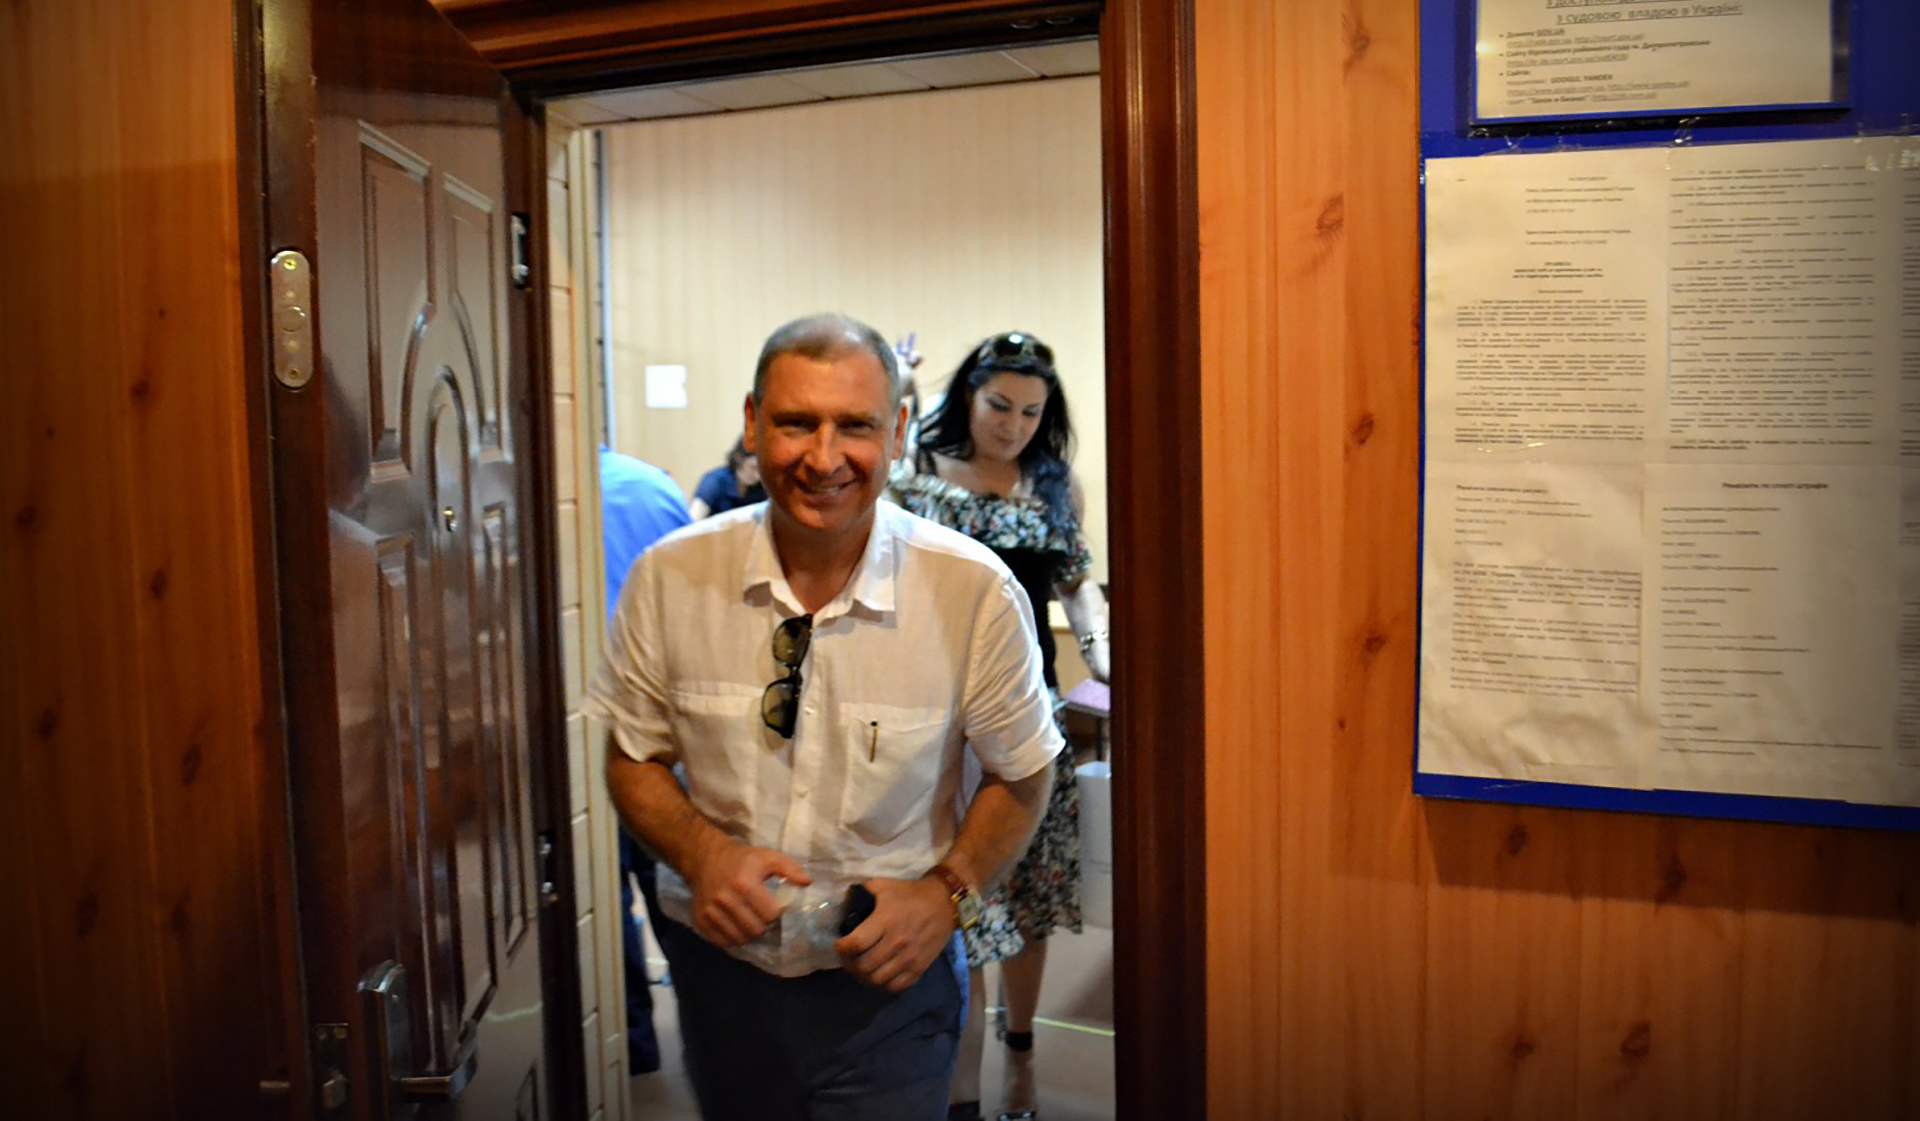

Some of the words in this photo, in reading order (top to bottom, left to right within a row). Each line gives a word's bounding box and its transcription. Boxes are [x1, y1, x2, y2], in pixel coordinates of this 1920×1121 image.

[1566, 11, 1621, 24] судовою
[1628, 7, 1679, 19] владою
[1681, 7, 1689, 15] в
